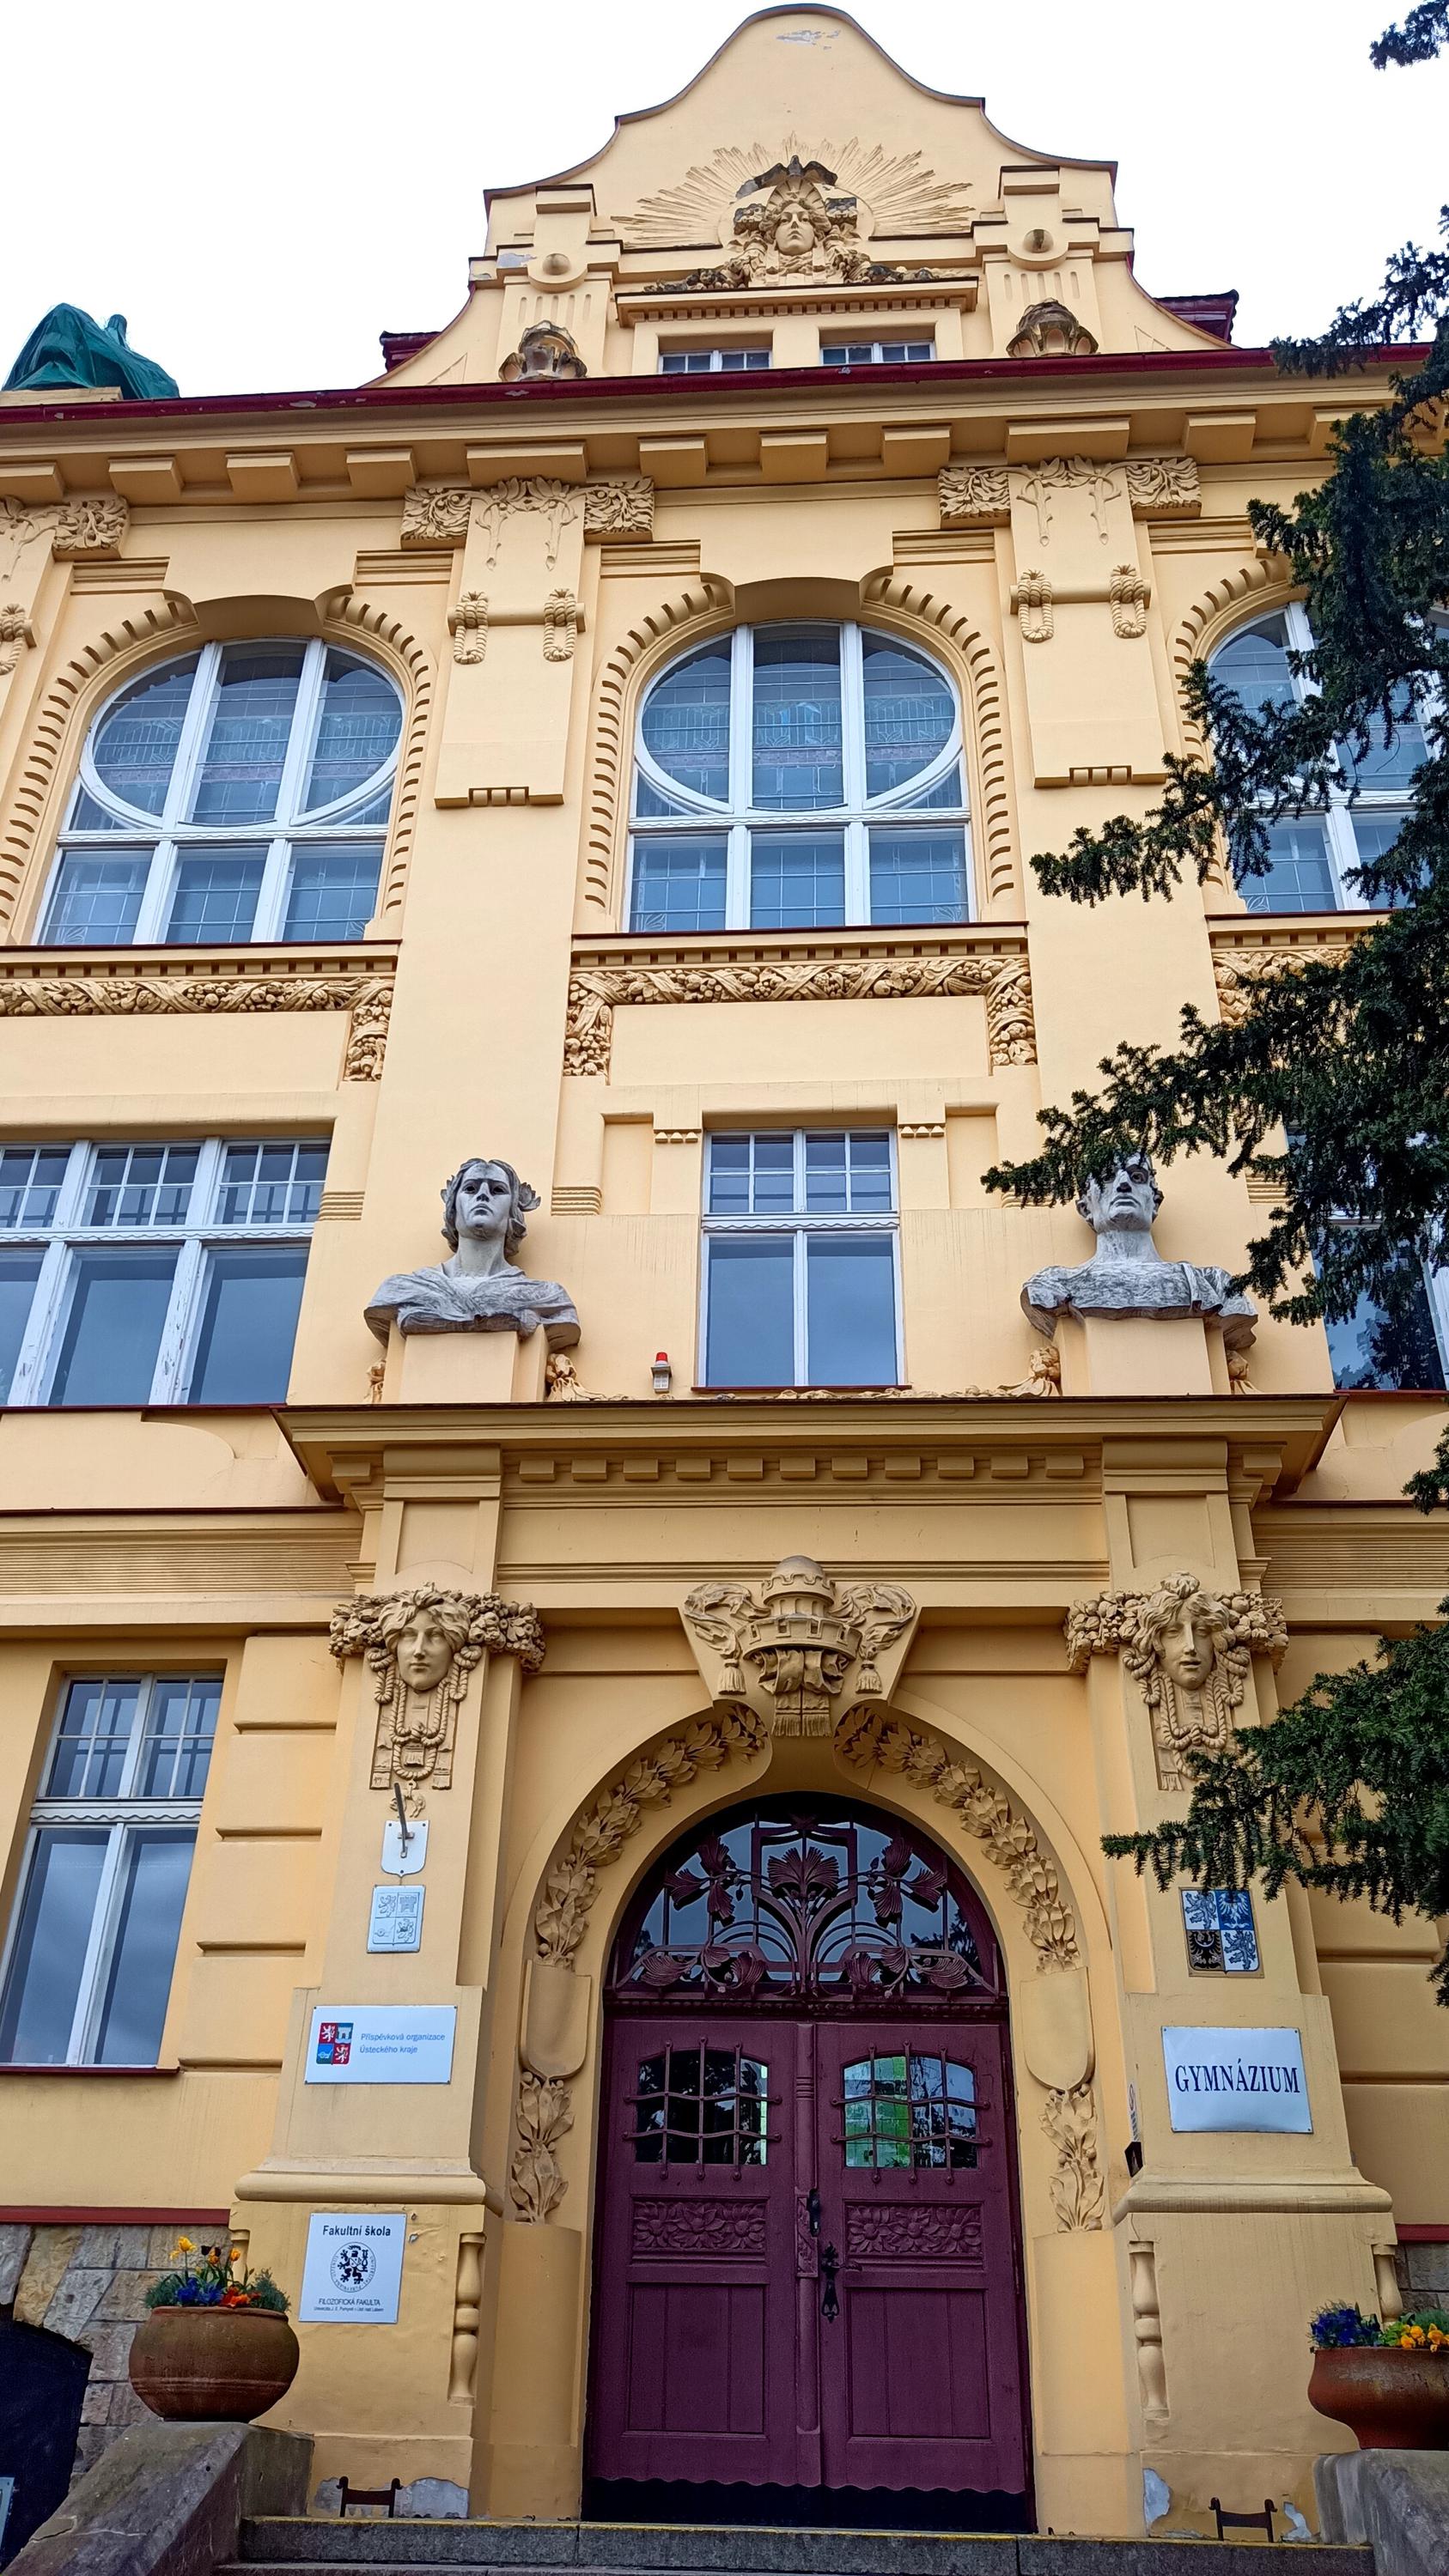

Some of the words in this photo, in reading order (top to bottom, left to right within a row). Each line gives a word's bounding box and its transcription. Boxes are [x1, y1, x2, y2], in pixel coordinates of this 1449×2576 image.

[361, 2032, 405, 2042] Příspěvková
[405, 2032, 446, 2042] organizace
[359, 2044, 399, 2053] Ústeckého
[399, 2044, 418, 2054] kraje
[1175, 2057, 1300, 2093] GYMNÁZIUM
[322, 2225, 362, 2236] Fakultní
[364, 2225, 391, 2237] škola
[319, 2297, 355, 2306] FILOZOFICKÁ
[356, 2298, 381, 2306] FAKULTA
